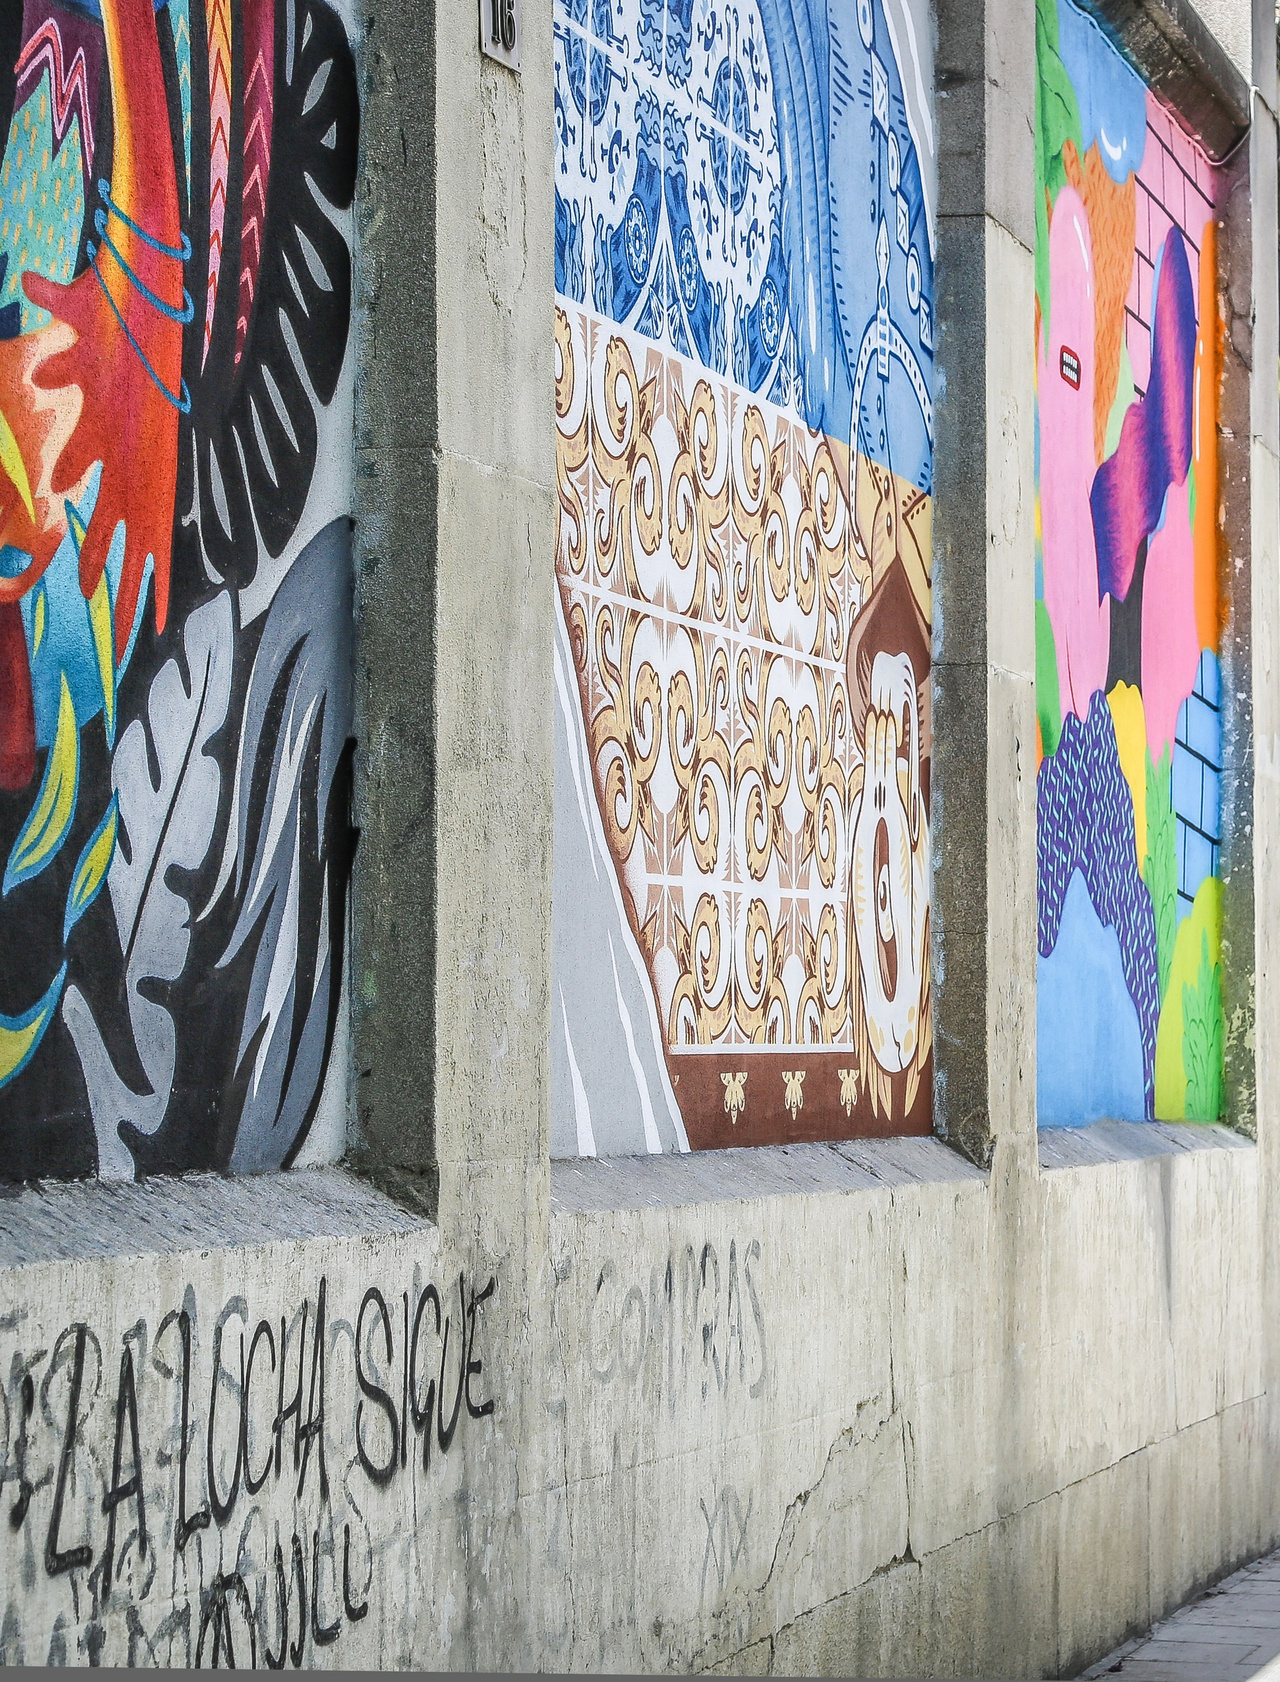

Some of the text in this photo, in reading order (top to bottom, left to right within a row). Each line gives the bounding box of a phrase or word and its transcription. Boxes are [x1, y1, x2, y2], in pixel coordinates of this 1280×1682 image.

[490, 0, 516, 51] 16
[174, 1275, 330, 1551] LUCHA
[355, 1270, 496, 1486] SIGUE
